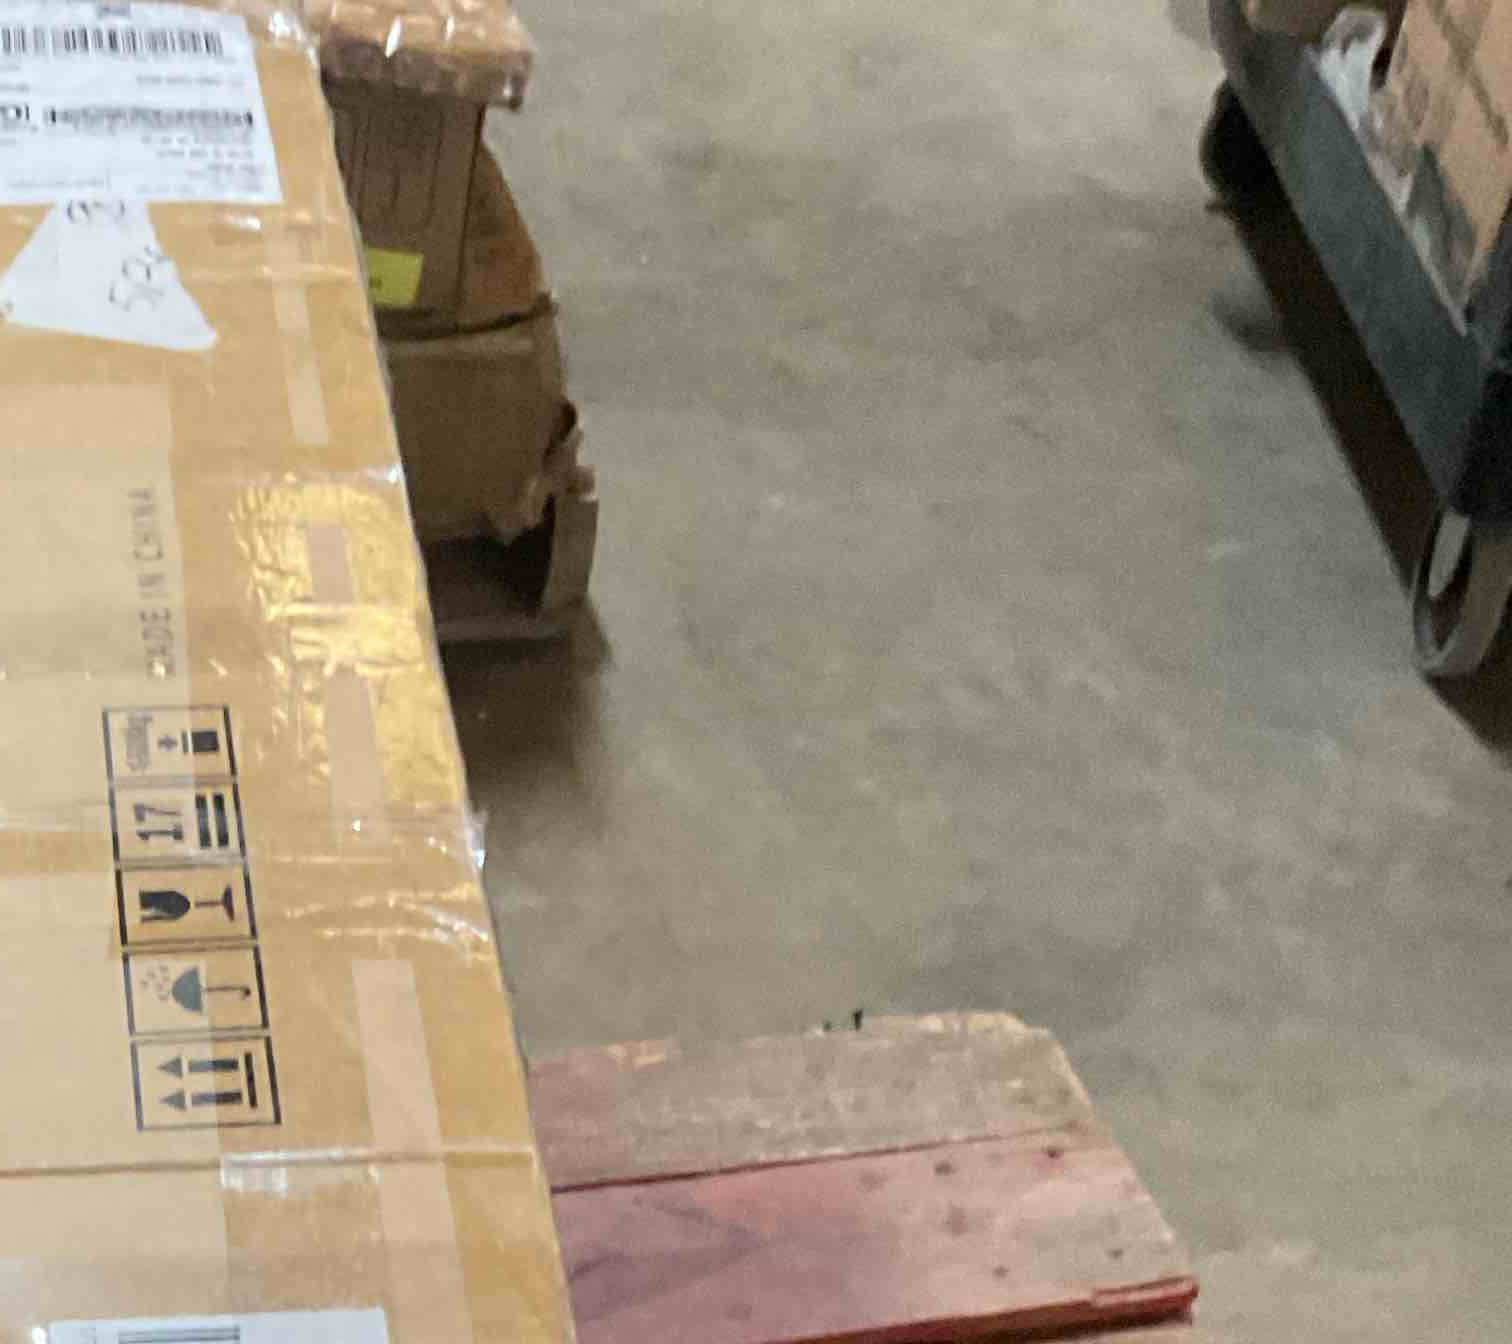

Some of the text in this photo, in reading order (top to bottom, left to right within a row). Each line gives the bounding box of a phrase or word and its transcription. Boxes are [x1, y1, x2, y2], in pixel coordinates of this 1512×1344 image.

[127, 485, 165, 561] CHINA
[136, 572, 167, 598] IN
[139, 606, 176, 680] MADE
